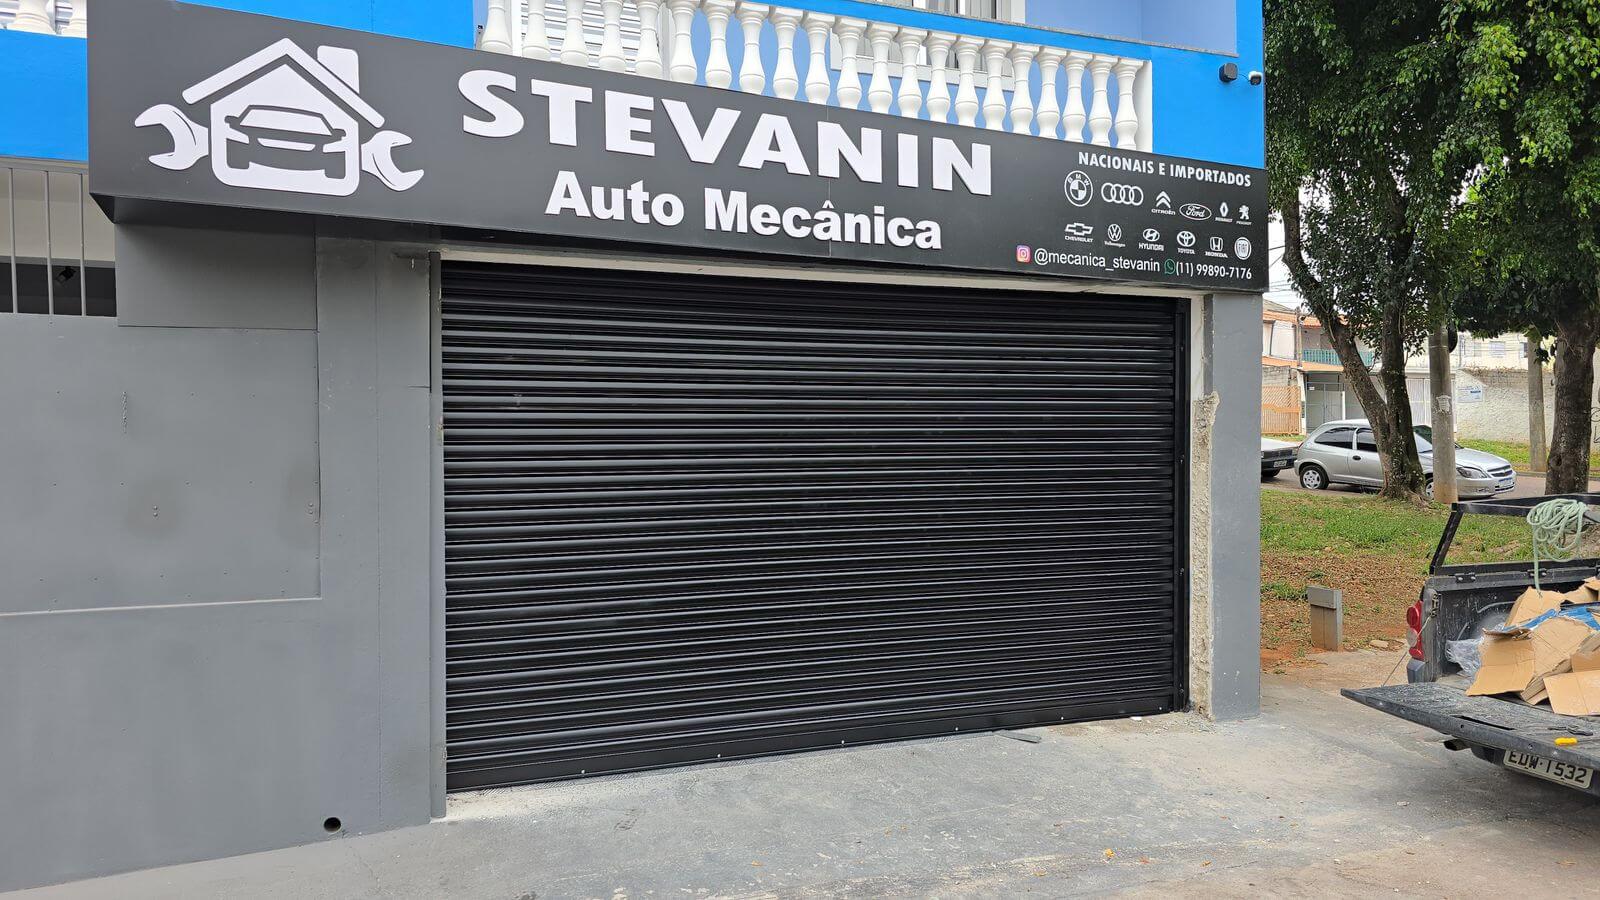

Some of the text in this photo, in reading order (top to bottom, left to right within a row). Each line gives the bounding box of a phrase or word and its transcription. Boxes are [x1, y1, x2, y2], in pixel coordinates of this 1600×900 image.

[457, 69, 992, 197] STEVANIN
[1078, 151, 1252, 188] NACIONAIS E IMPORTADOS
[545, 169, 942, 250] Auto Mecânica
[1185, 205, 1206, 218] Ford
[1034, 247, 1160, 272] @mecanica_stevanin
[1205, 251, 1228, 259] HONDA
[1176, 261, 1252, 280] (11) 99890-7176
